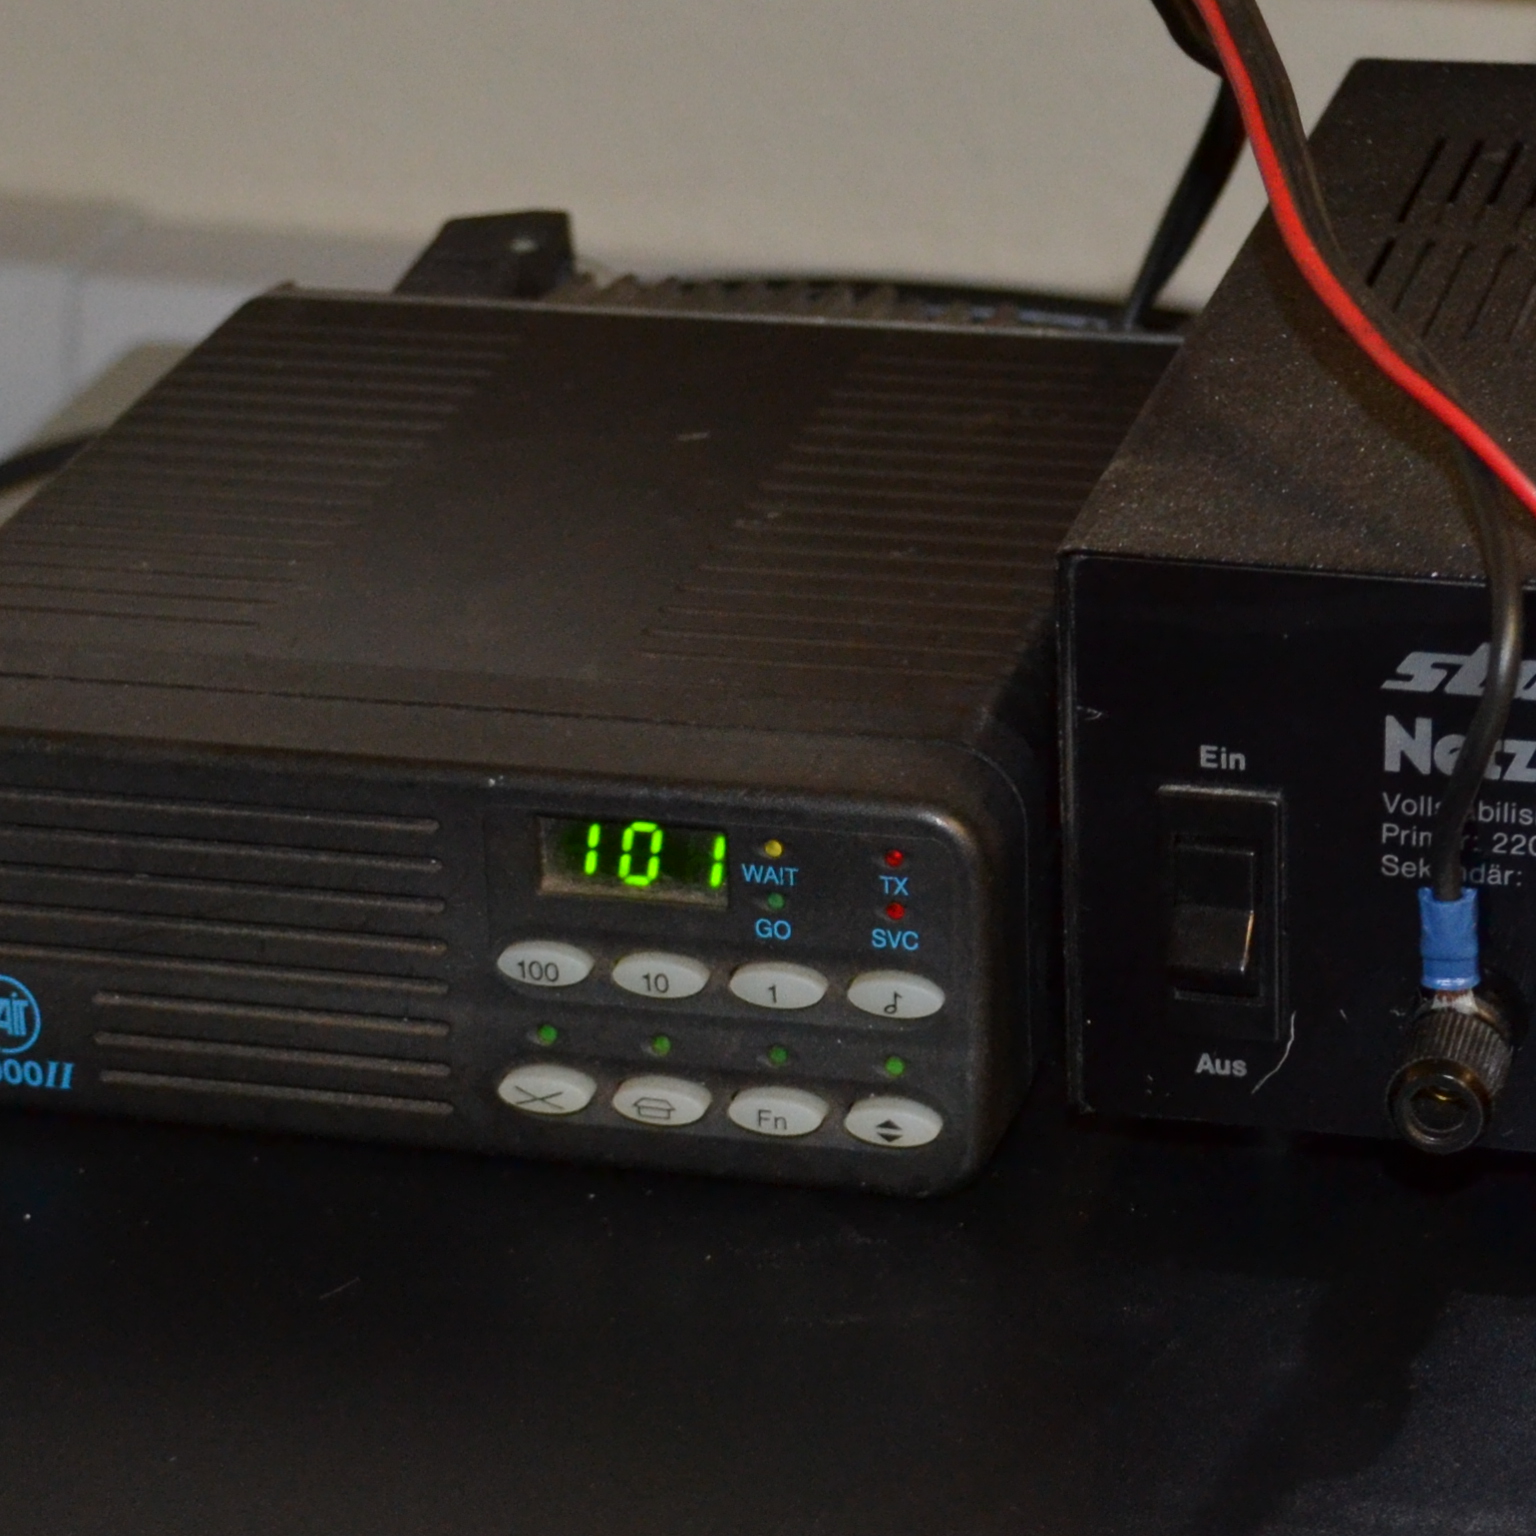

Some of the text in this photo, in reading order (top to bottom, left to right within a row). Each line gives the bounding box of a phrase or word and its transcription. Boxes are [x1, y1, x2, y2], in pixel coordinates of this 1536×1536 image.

[1199, 745, 1246, 770] Ein
[584, 821, 726, 888] 101
[742, 863, 799, 887] WAIT
[1381, 854, 1522, 887] Sekdär:
[879, 875, 909, 897] TX
[755, 918, 792, 941] GO
[871, 928, 920, 952] SVC
[517, 960, 560, 984] 100
[642, 972, 670, 995] 10
[767, 984, 778, 1004] 1
[1195, 1053, 1247, 1077] Aus
[757, 1109, 788, 1131] Fn
